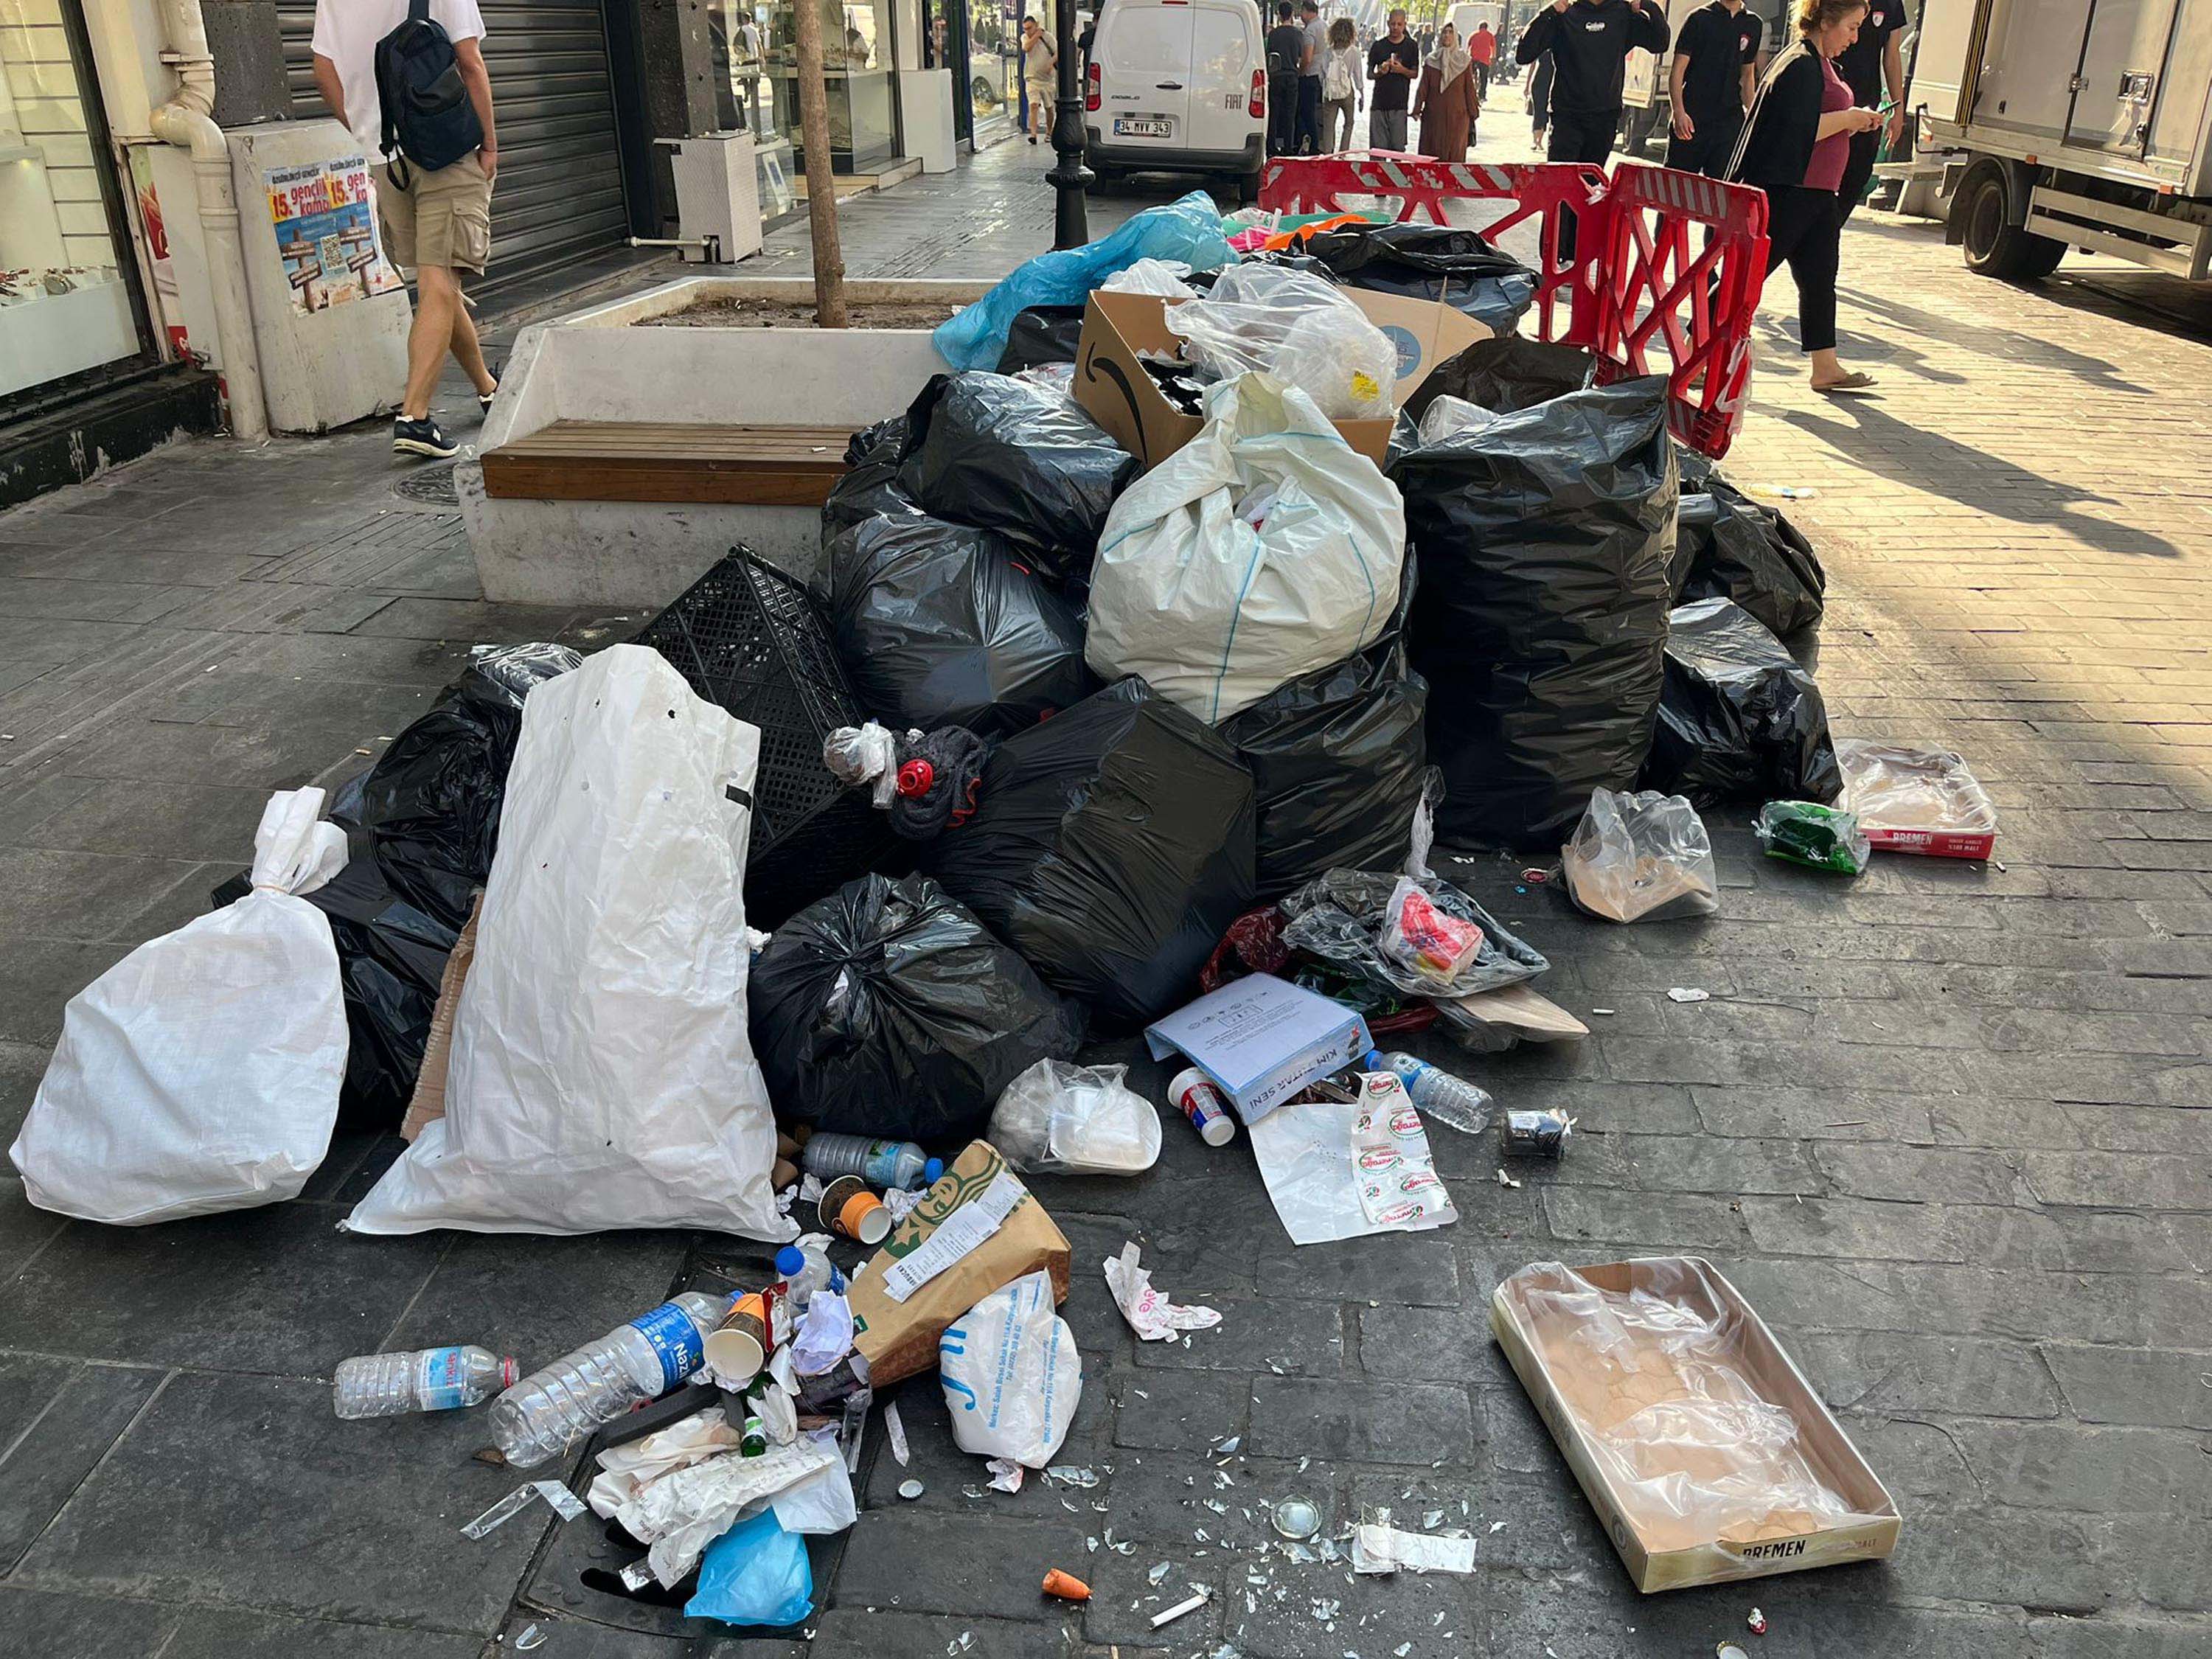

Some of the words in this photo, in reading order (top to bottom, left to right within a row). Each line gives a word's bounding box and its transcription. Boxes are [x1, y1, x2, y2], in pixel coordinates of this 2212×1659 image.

[1225, 94, 1243, 109] FIAT
[1120, 122, 1130, 131] 34
[1153, 123, 1169, 133] 343
[1892, 832, 1933, 845] BREMEN
